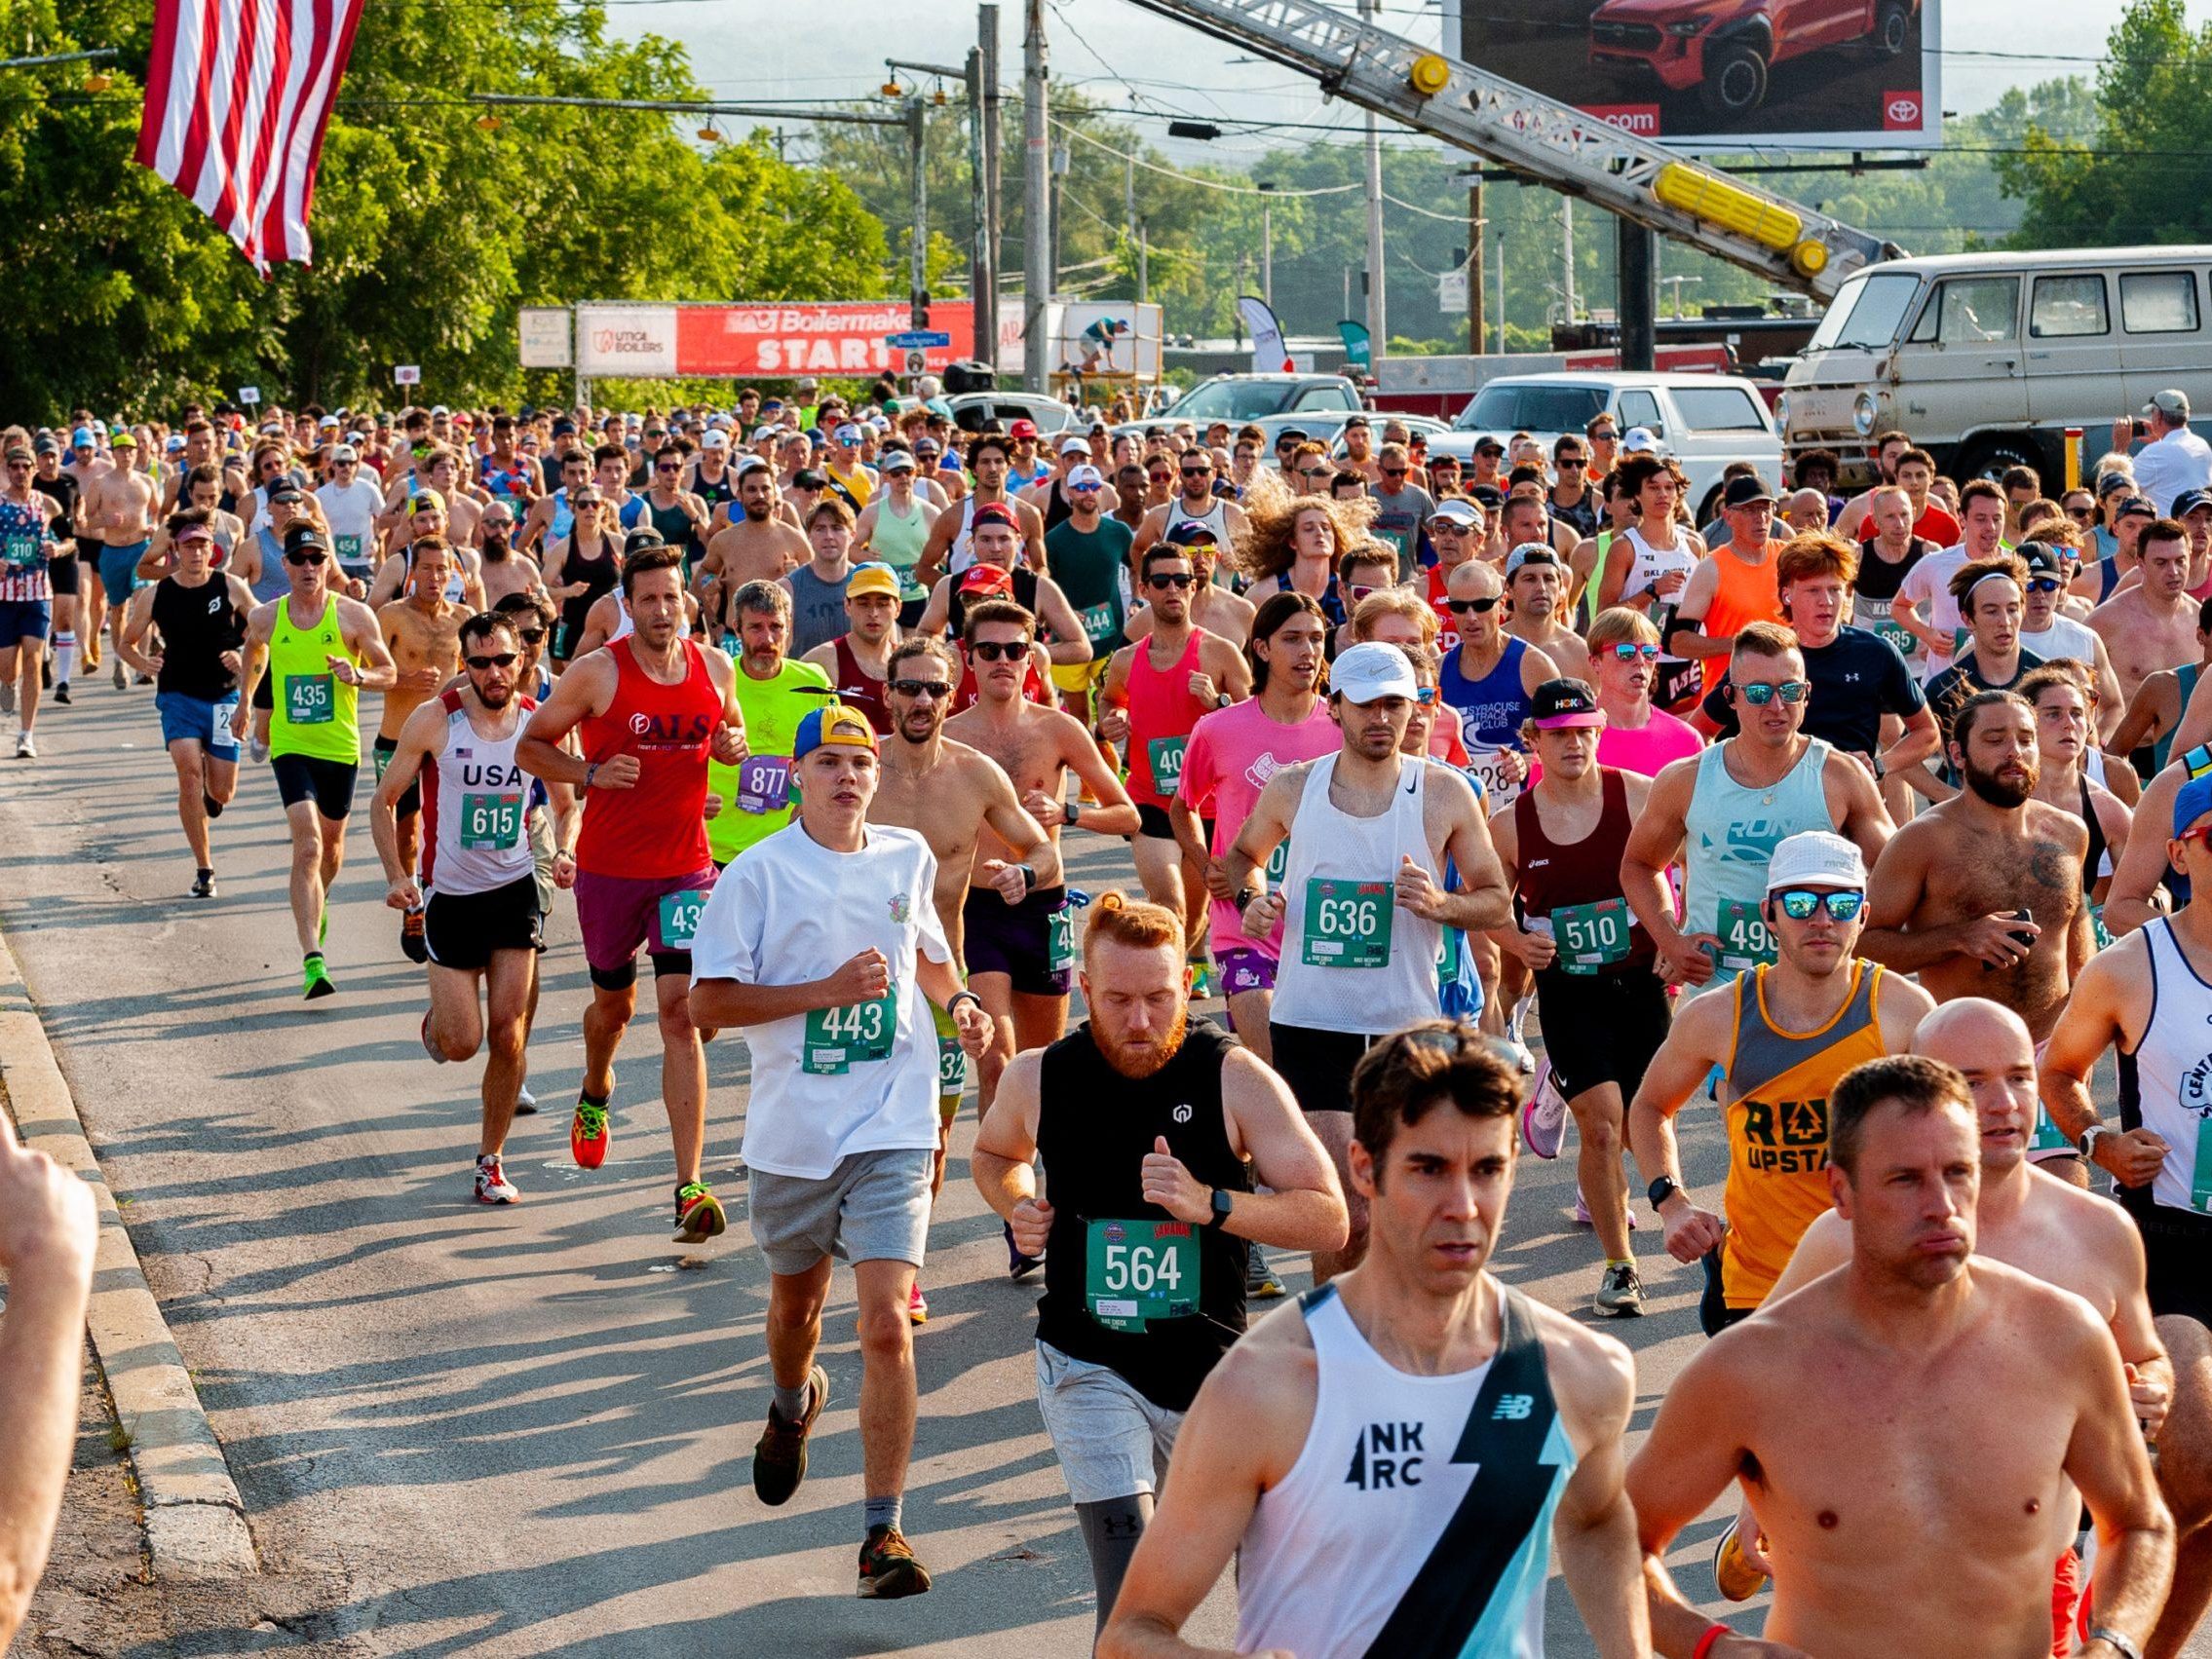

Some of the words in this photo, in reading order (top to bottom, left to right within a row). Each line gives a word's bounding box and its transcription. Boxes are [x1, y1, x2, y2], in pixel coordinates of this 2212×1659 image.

[616, 342, 665, 353] BOILERS
[757, 338, 891, 370] START
[11, 543, 33, 558] 310
[1085, 612, 1109, 631] 444
[292, 684, 326, 706] 435
[1468, 701, 1520, 715] SYRACUSE
[1554, 698, 1583, 710] HOKA
[1473, 710, 1507, 724] TRACK
[1481, 718, 1508, 731] CLUB
[463, 765, 522, 786] USA
[751, 767, 786, 794] 877
[473, 808, 514, 835] 615
[672, 905, 701, 933] 43
[1318, 898, 1377, 936] 636
[1565, 916, 1618, 951] 510
[821, 1002, 885, 1040] 443
[1105, 1245, 1182, 1291] 564
[1370, 1421, 1425, 1454] NK
[1371, 1457, 1424, 1489] RC
